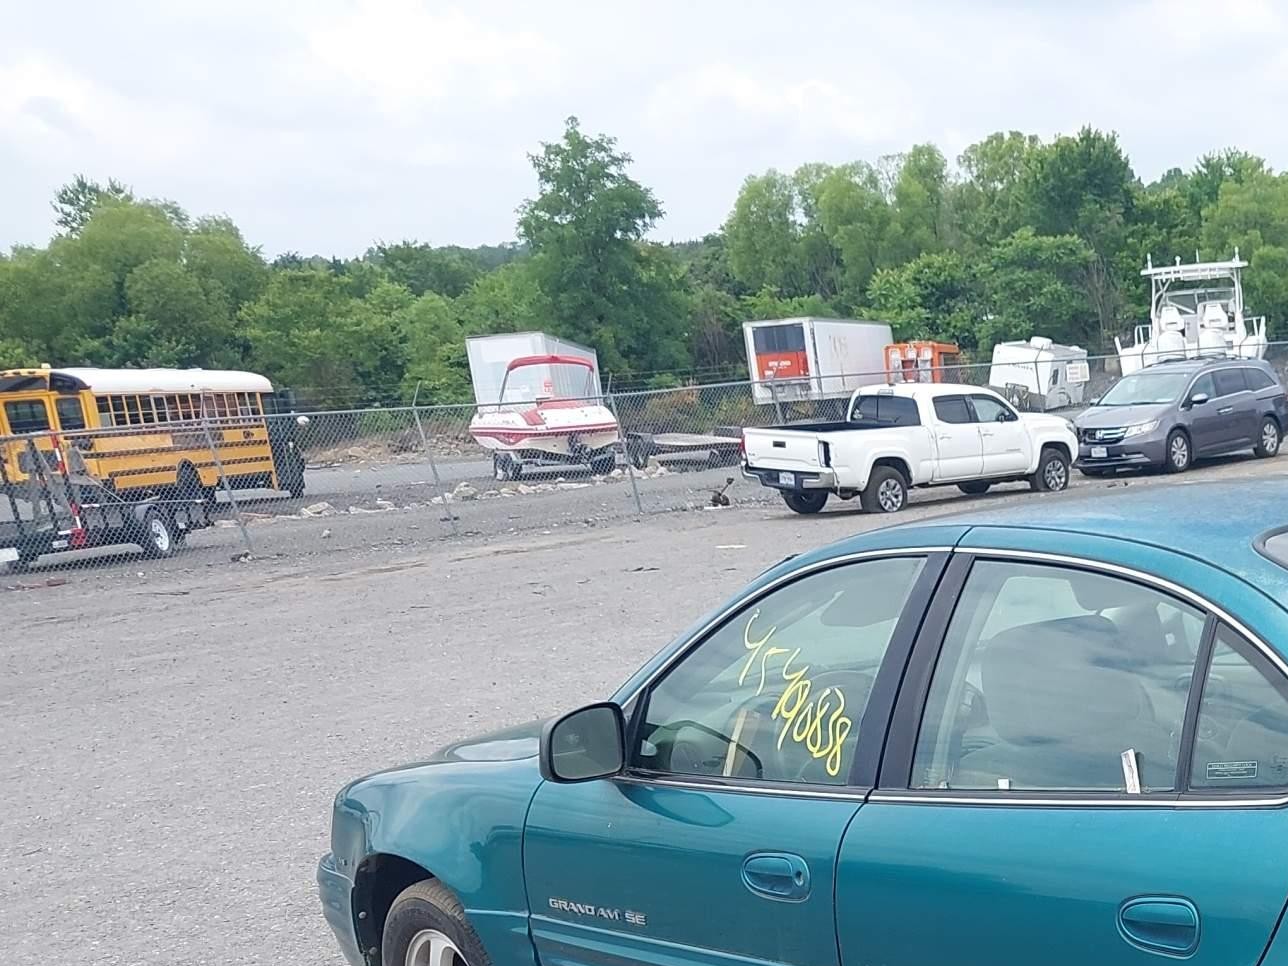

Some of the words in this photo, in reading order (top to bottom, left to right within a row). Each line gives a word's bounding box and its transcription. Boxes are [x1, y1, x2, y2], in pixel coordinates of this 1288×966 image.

[738, 608, 852, 777] 45490838
[548, 897, 595, 915] GRAND
[596, 907, 621, 921] AM
[624, 911, 648, 926] SE
